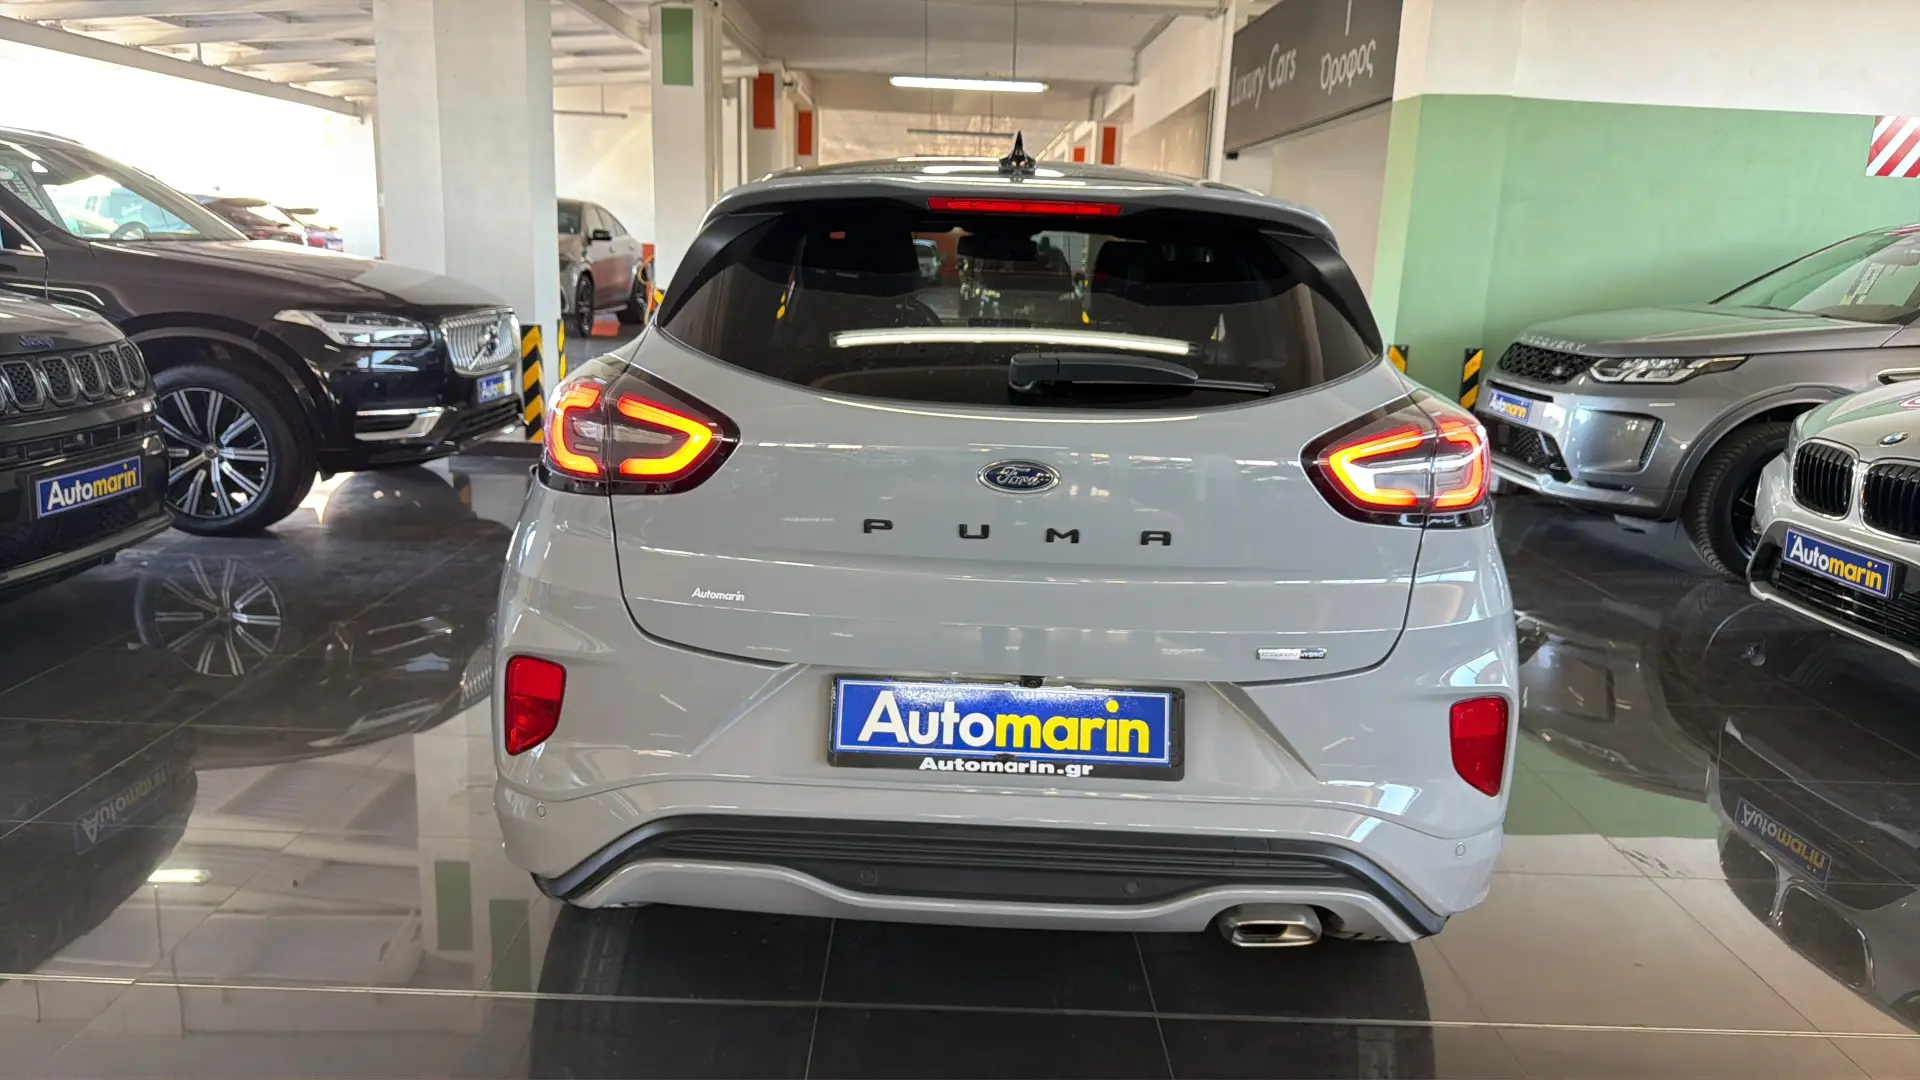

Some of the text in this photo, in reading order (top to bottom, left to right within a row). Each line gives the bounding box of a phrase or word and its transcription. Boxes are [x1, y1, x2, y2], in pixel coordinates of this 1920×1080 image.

[1267, 42, 1297, 90] Cars
[47, 463, 137, 510] Automarin
[996, 466, 1041, 486] Ford
[1789, 536, 1882, 591] Automarin
[691, 587, 745, 602] Automarin
[857, 690, 1150, 754] Automarin
[919, 757, 1093, 778] Automarin.gr
